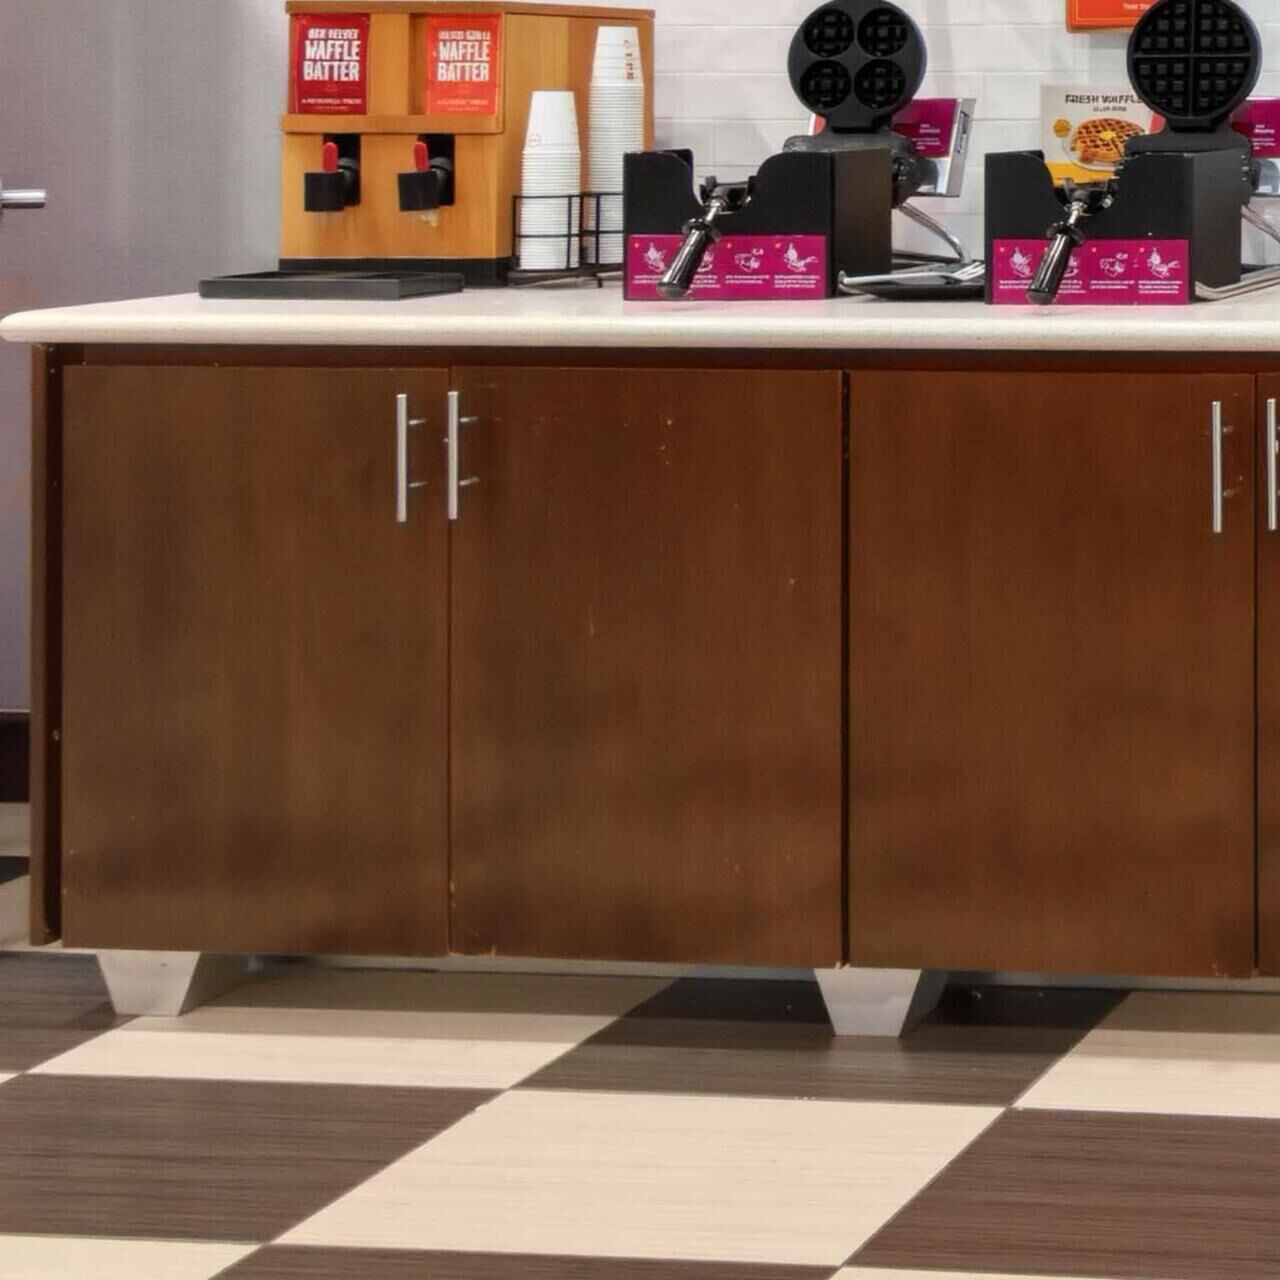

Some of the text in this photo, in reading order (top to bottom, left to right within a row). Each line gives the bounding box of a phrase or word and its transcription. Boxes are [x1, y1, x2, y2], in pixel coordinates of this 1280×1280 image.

[305, 40, 361, 61] WAFFLE
[439, 41, 491, 61] WAFFLE
[303, 61, 360, 81] BATTER
[437, 61, 489, 82] BATTER
[1065, 94, 1099, 104] FRESH
